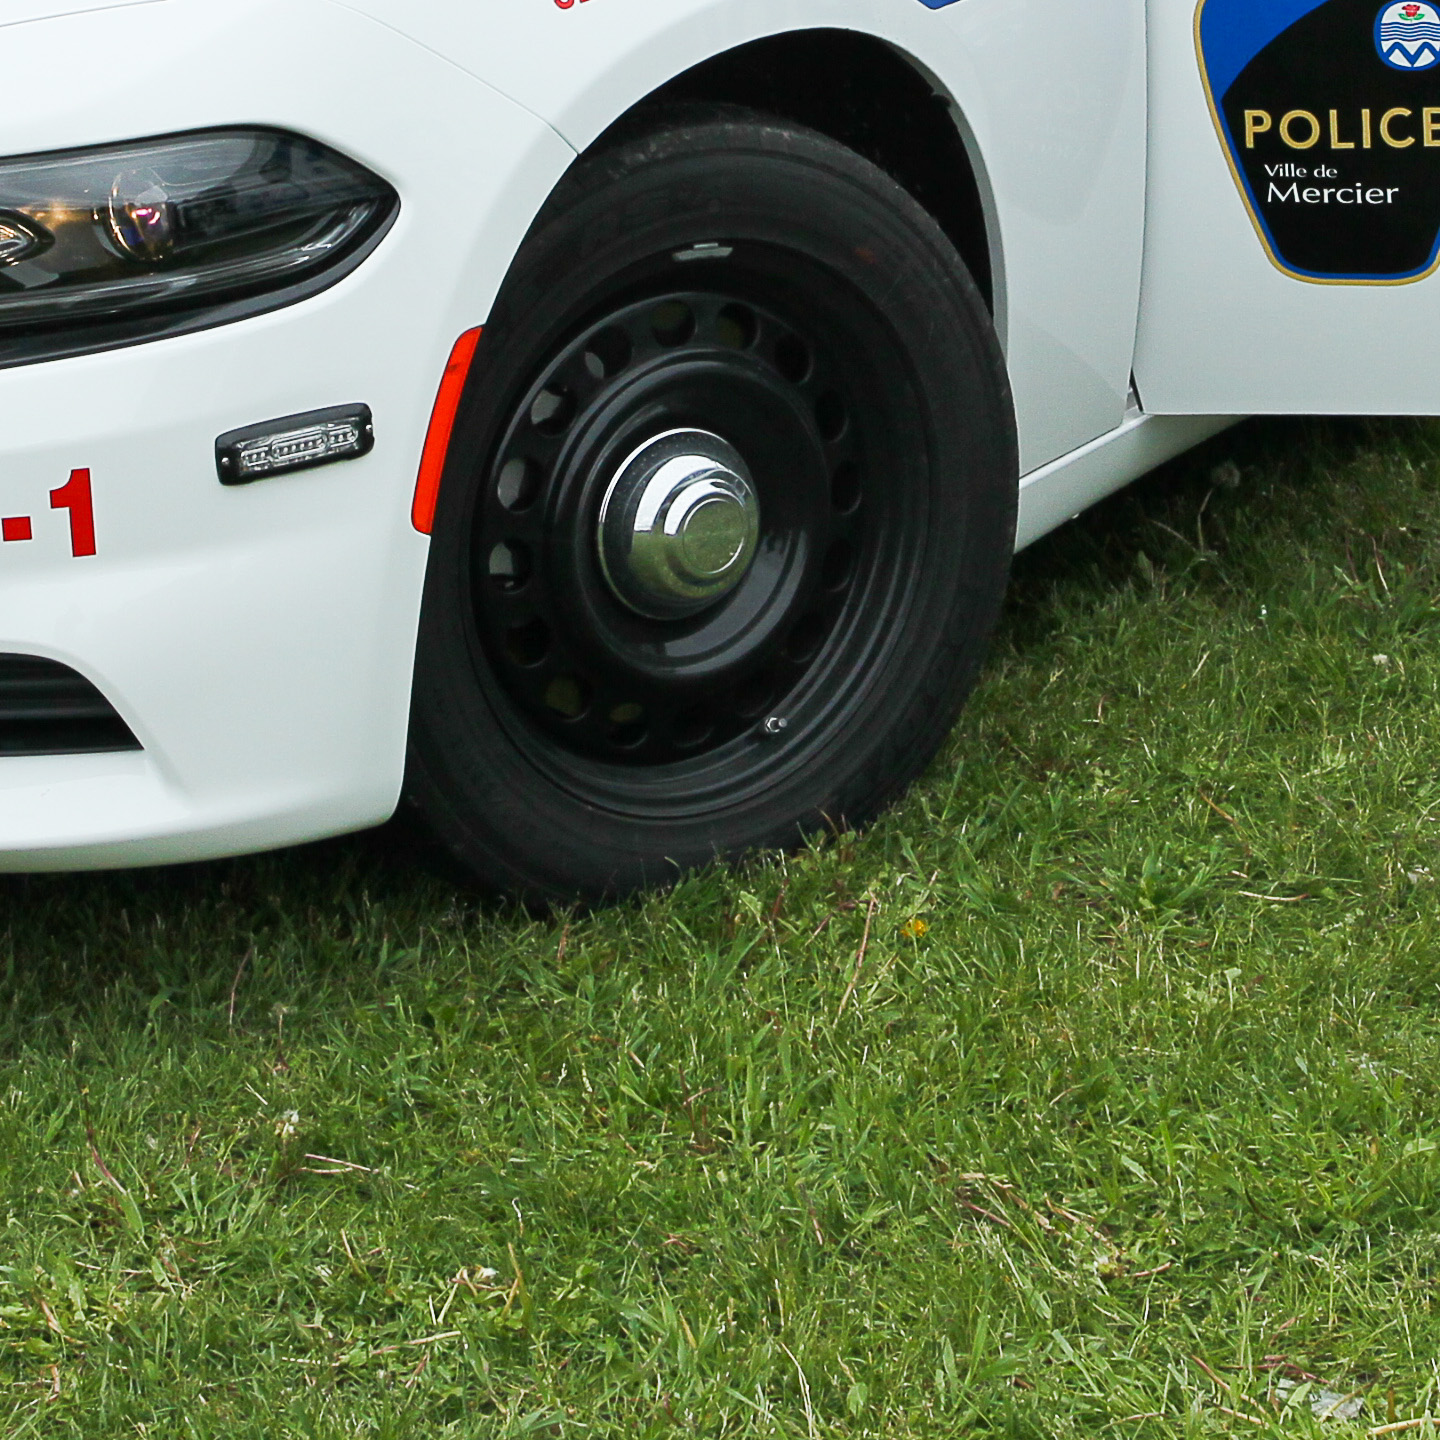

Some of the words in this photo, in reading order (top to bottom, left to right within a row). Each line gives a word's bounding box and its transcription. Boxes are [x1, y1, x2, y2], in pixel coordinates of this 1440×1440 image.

[1264, 163, 1307, 178] Ville
[1313, 164, 1338, 178] de
[1266, 182, 1400, 205] Mercier
